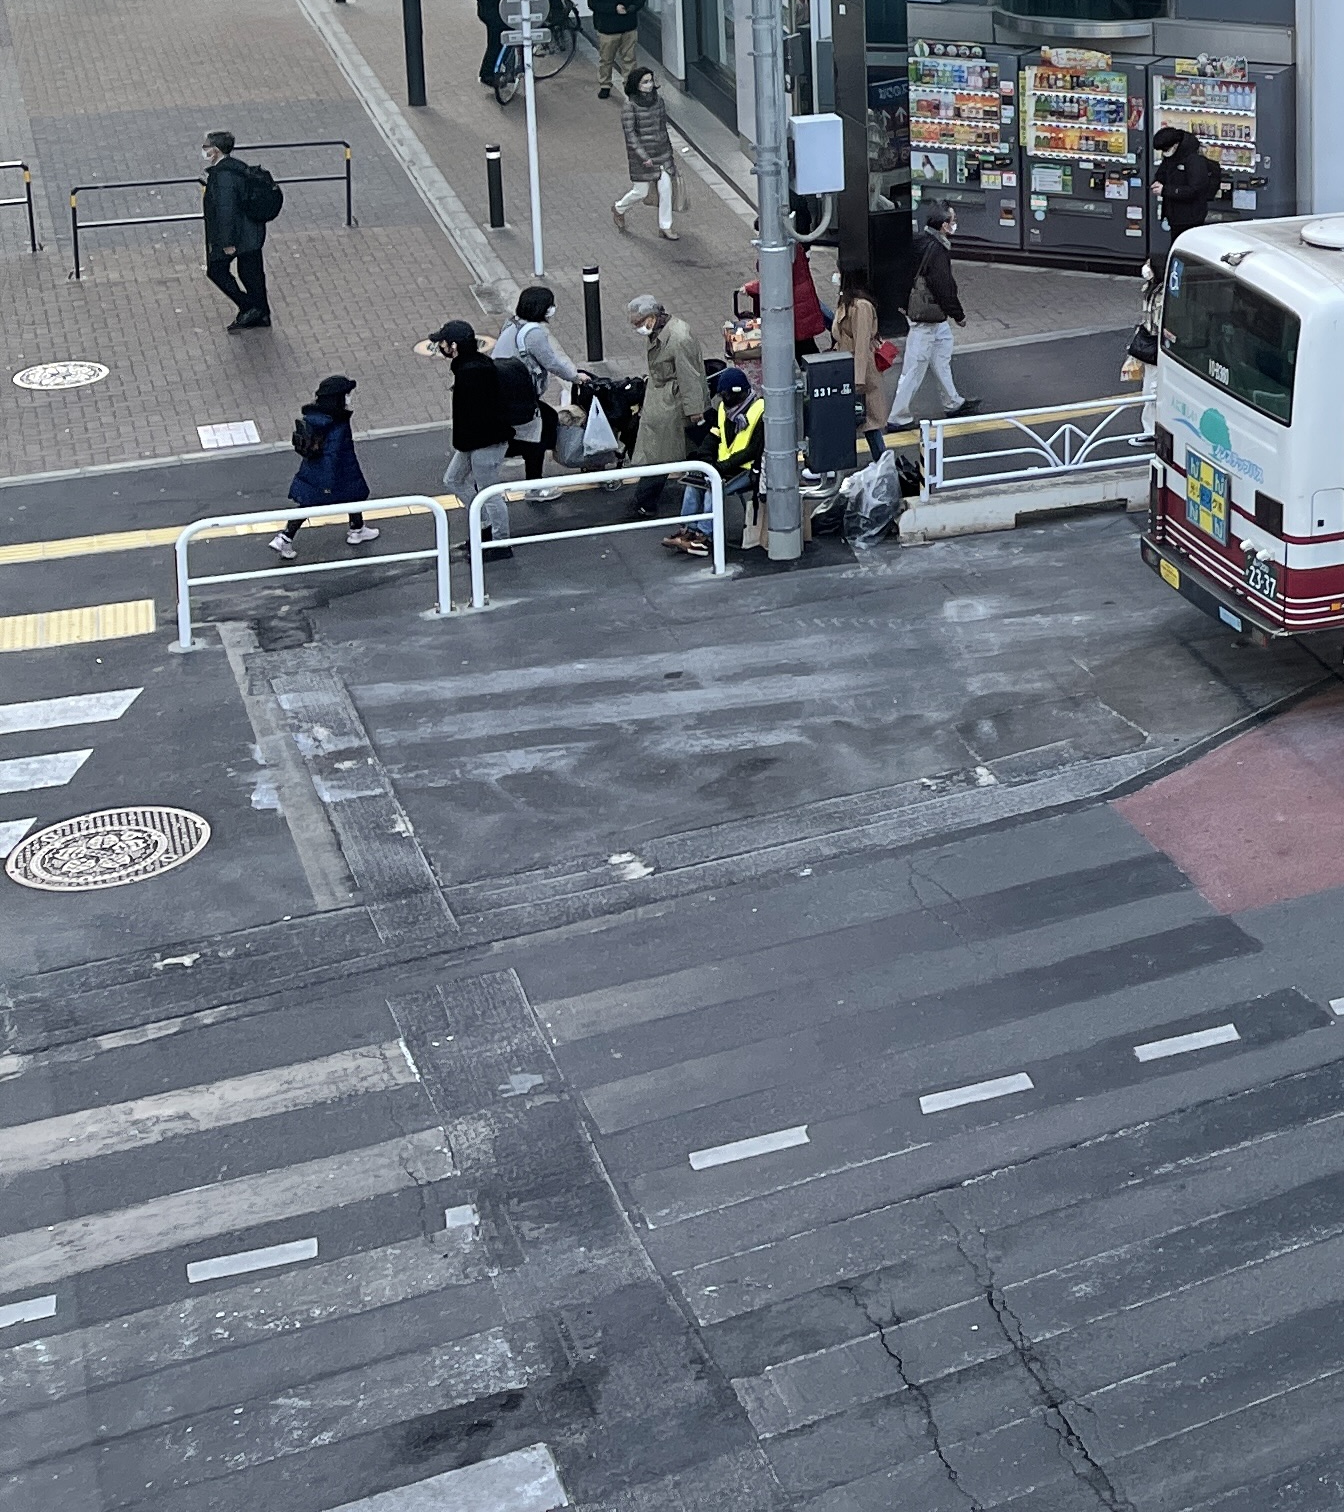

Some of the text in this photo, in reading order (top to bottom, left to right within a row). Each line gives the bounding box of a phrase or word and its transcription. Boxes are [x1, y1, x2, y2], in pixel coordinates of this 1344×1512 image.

[1215, 444, 1265, 485] ノンステップバス
[1249, 565, 1277, 598] 23-37
